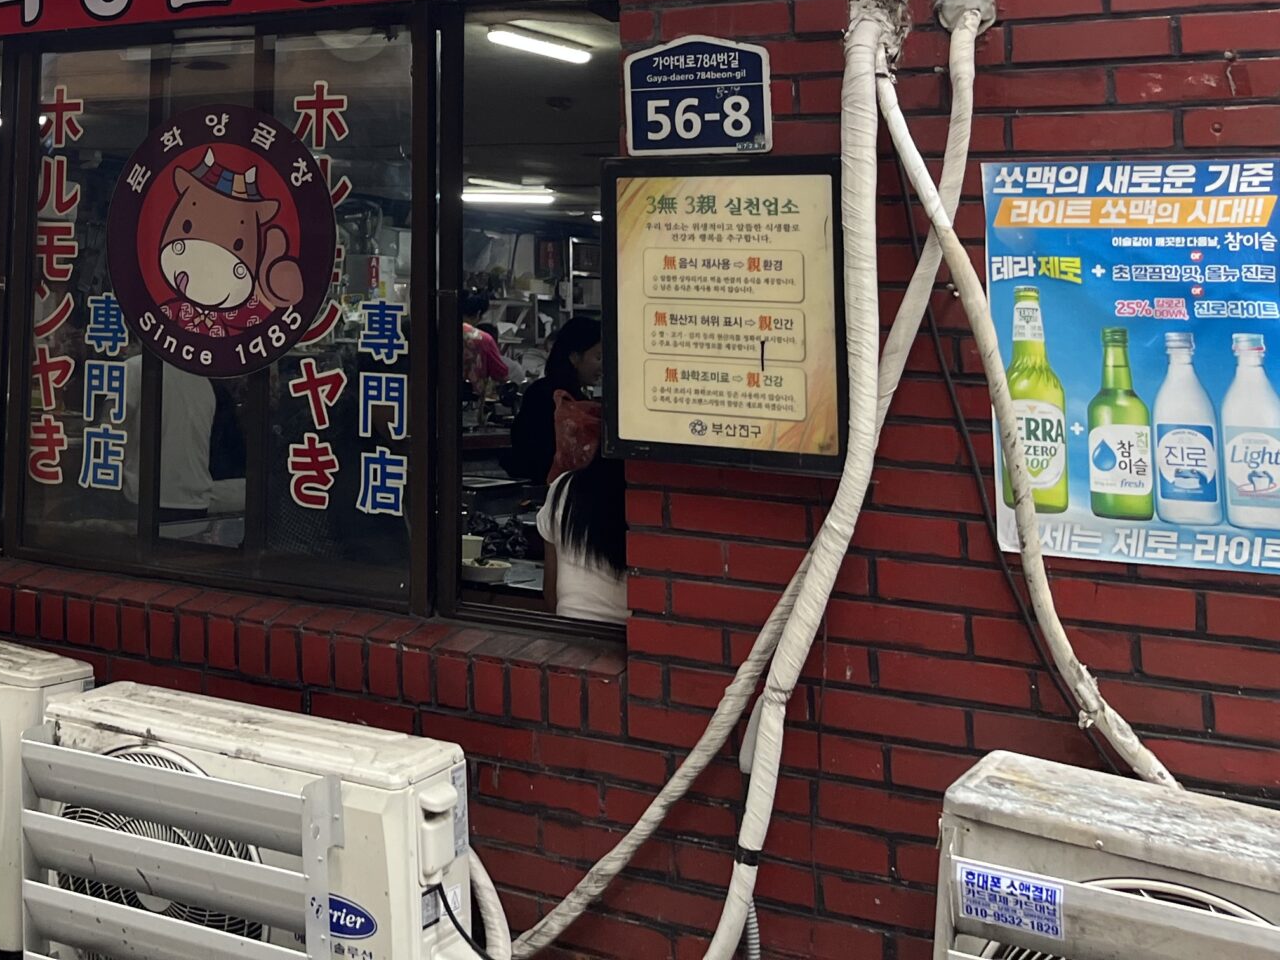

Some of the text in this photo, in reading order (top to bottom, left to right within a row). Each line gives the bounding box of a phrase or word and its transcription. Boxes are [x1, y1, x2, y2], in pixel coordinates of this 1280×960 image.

[652, 51, 740, 71] 가야대로784번길
[646, 68, 747, 83] Gaya-daero 784beon-gil
[646, 95, 752, 141] 56-8
[126, 111, 315, 196] 문화양곱창
[992, 162, 1275, 195] 쏘맥의 새로운 기준
[645, 194, 678, 215] 3無
[724, 196, 801, 217] 실천업소
[1009, 197, 1265, 225] 라이트 쏘맥의 시대!!
[1223, 231, 1279, 252] 참이슬
[678, 257, 699, 269] 음식
[701, 258, 732, 271] 재사용
[762, 259, 784, 272] 환경
[990, 256, 1277, 284] 테라 제로 초 깔끔한 맛, 올뉴 진로
[1115, 299, 1280, 320] 25% 진로 라이트
[669, 314, 698, 327] 원산지
[700, 315, 721, 328] 허위
[722, 316, 743, 328] 표시
[773, 318, 795, 331] 인간
[234, 304, 302, 365] 1985
[680, 369, 730, 384] 화학조미료
[762, 375, 784, 388] 건강
[1023, 444, 1058, 457] ZERO
[1163, 445, 1209, 469] 진로
[1230, 444, 1280, 469] Light
[1119, 477, 1146, 489] fresh
[964, 870, 1058, 907] 휴대폰 소액결제
